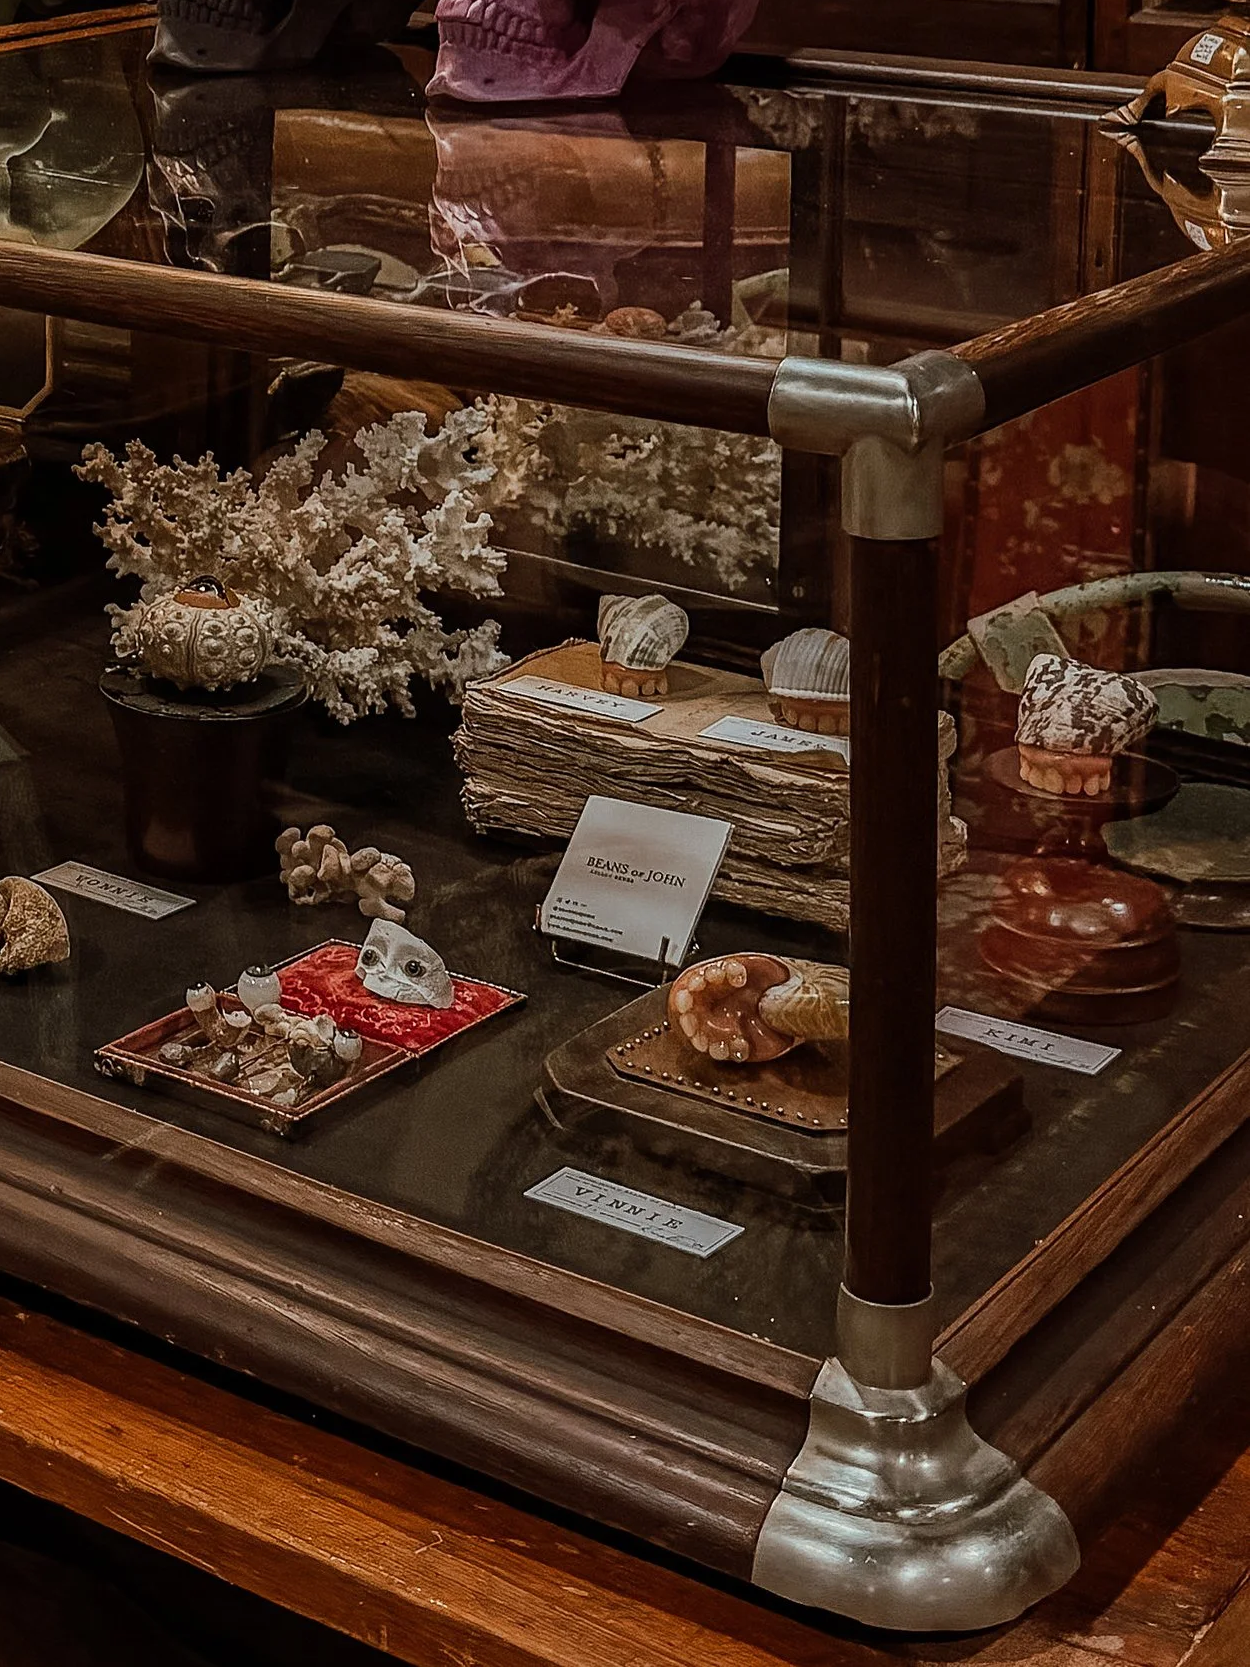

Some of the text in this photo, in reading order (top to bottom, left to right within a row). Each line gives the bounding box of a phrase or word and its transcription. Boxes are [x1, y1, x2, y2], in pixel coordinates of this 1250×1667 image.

[586, 856, 630, 875] BEANS
[643, 869, 686, 888] JOHN
[983, 1027, 1055, 1051] KIMI
[575, 1185, 684, 1230] VINNIE
